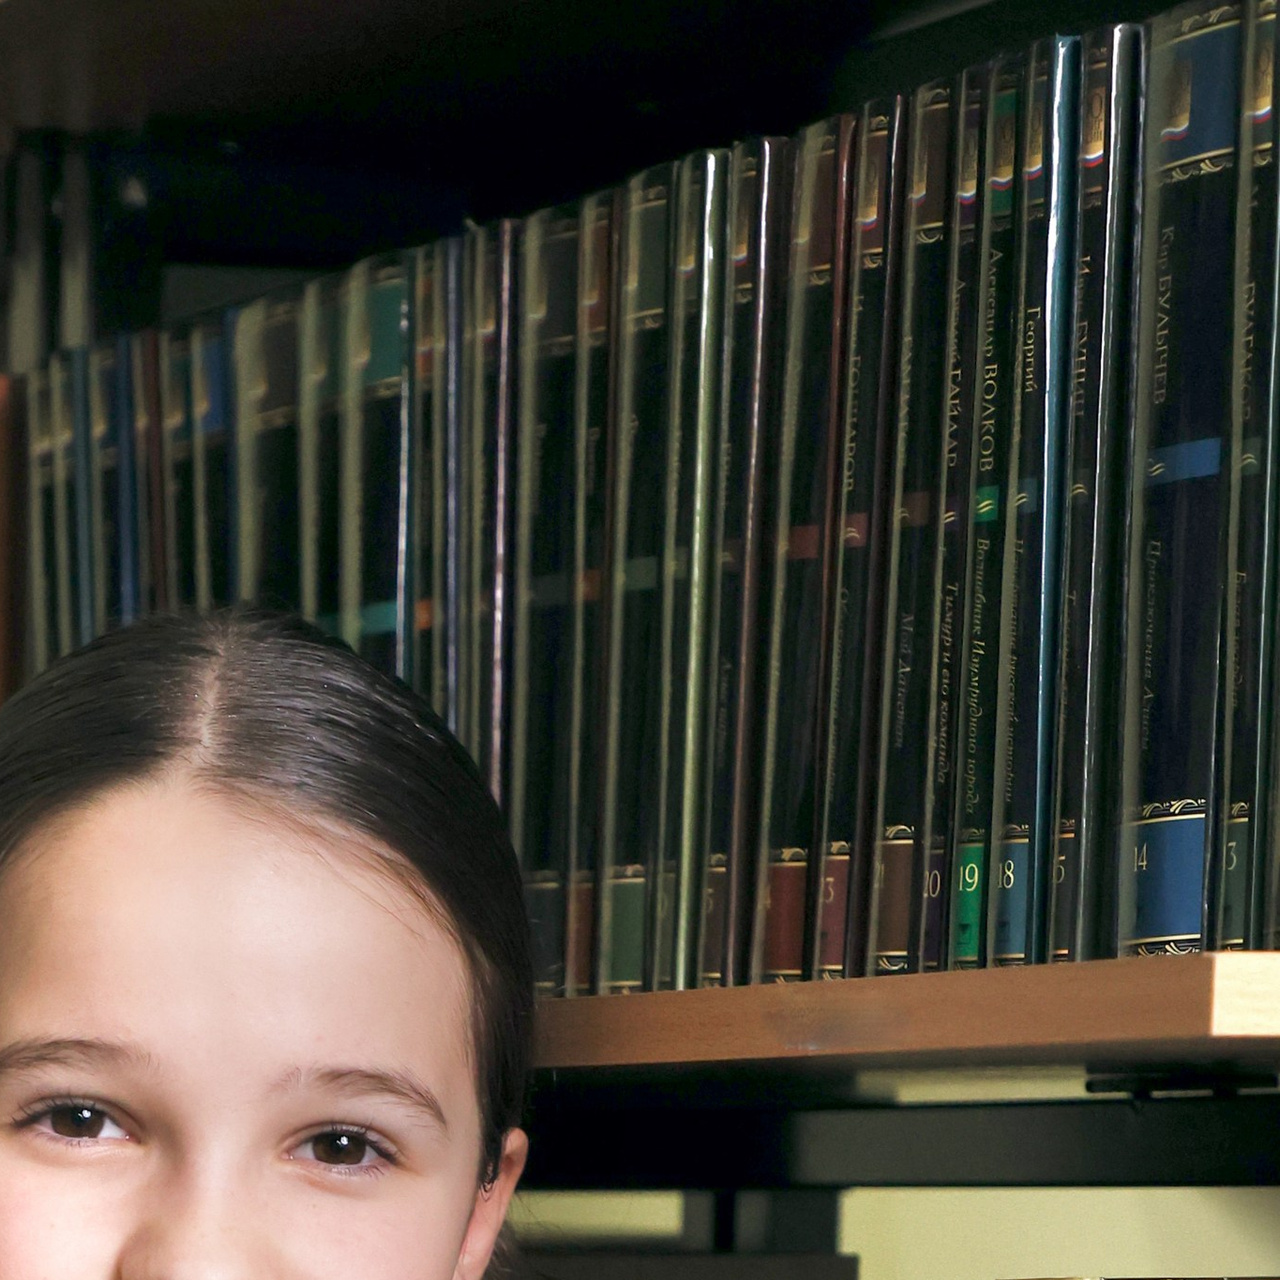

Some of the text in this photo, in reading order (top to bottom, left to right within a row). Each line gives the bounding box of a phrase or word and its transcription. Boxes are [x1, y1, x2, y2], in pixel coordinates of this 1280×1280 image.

[978, 250, 1004, 473] Александр ВОЛКОВ
[1024, 305, 1042, 394] Георгий
[1153, 275, 1174, 406] БУЛЫЧЕВ
[940, 581, 960, 648] Тимур
[973, 537, 991, 636] Волшебник
[967, 639, 988, 754] Изумрудного
[936, 701, 954, 785] команда
[958, 863, 979, 892] 19
[998, 859, 1015, 889] 18
[1133, 841, 1148, 872] 14
